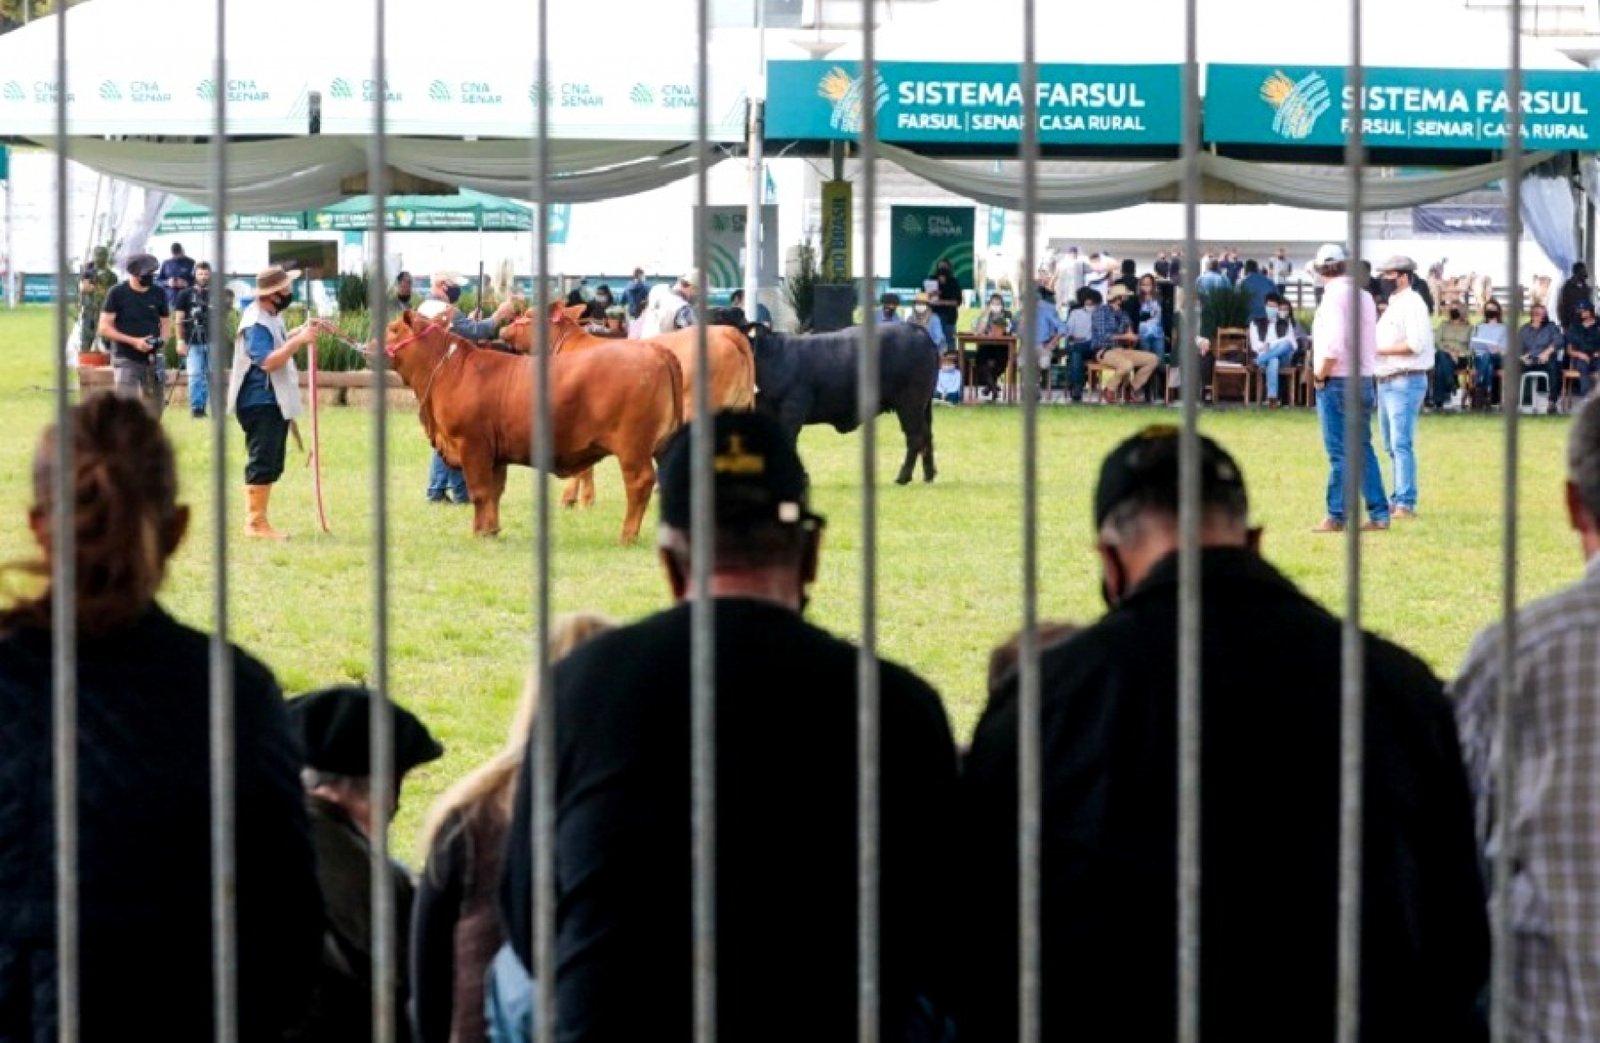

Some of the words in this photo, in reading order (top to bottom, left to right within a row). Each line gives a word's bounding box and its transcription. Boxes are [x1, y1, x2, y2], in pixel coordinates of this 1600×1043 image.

[227, 80, 257, 91] CNA
[461, 82, 490, 93] CNA
[561, 83, 590, 94] CNA
[661, 84, 690, 95] CNA
[34, 94, 75, 103] SENR
[227, 91, 269, 102] SENAR
[362, 92, 402, 102] SEAR
[461, 94, 502, 104] SENAR
[898, 81, 1025, 107] SISTEMA
[1035, 82, 1146, 108] FARSUL
[1341, 85, 1470, 113] SISTEMA
[1477, 89, 1589, 115] FARSUL
[561, 96, 603, 107] SENAR
[661, 97, 702, 107] SENA
[898, 113, 962, 129] FARSUL
[1039, 114, 1085, 130] CASA
[1088, 115, 1147, 130] RURAL
[1413, 120, 1474, 137] SENAR
[1532, 123, 1589, 139] RURAL
